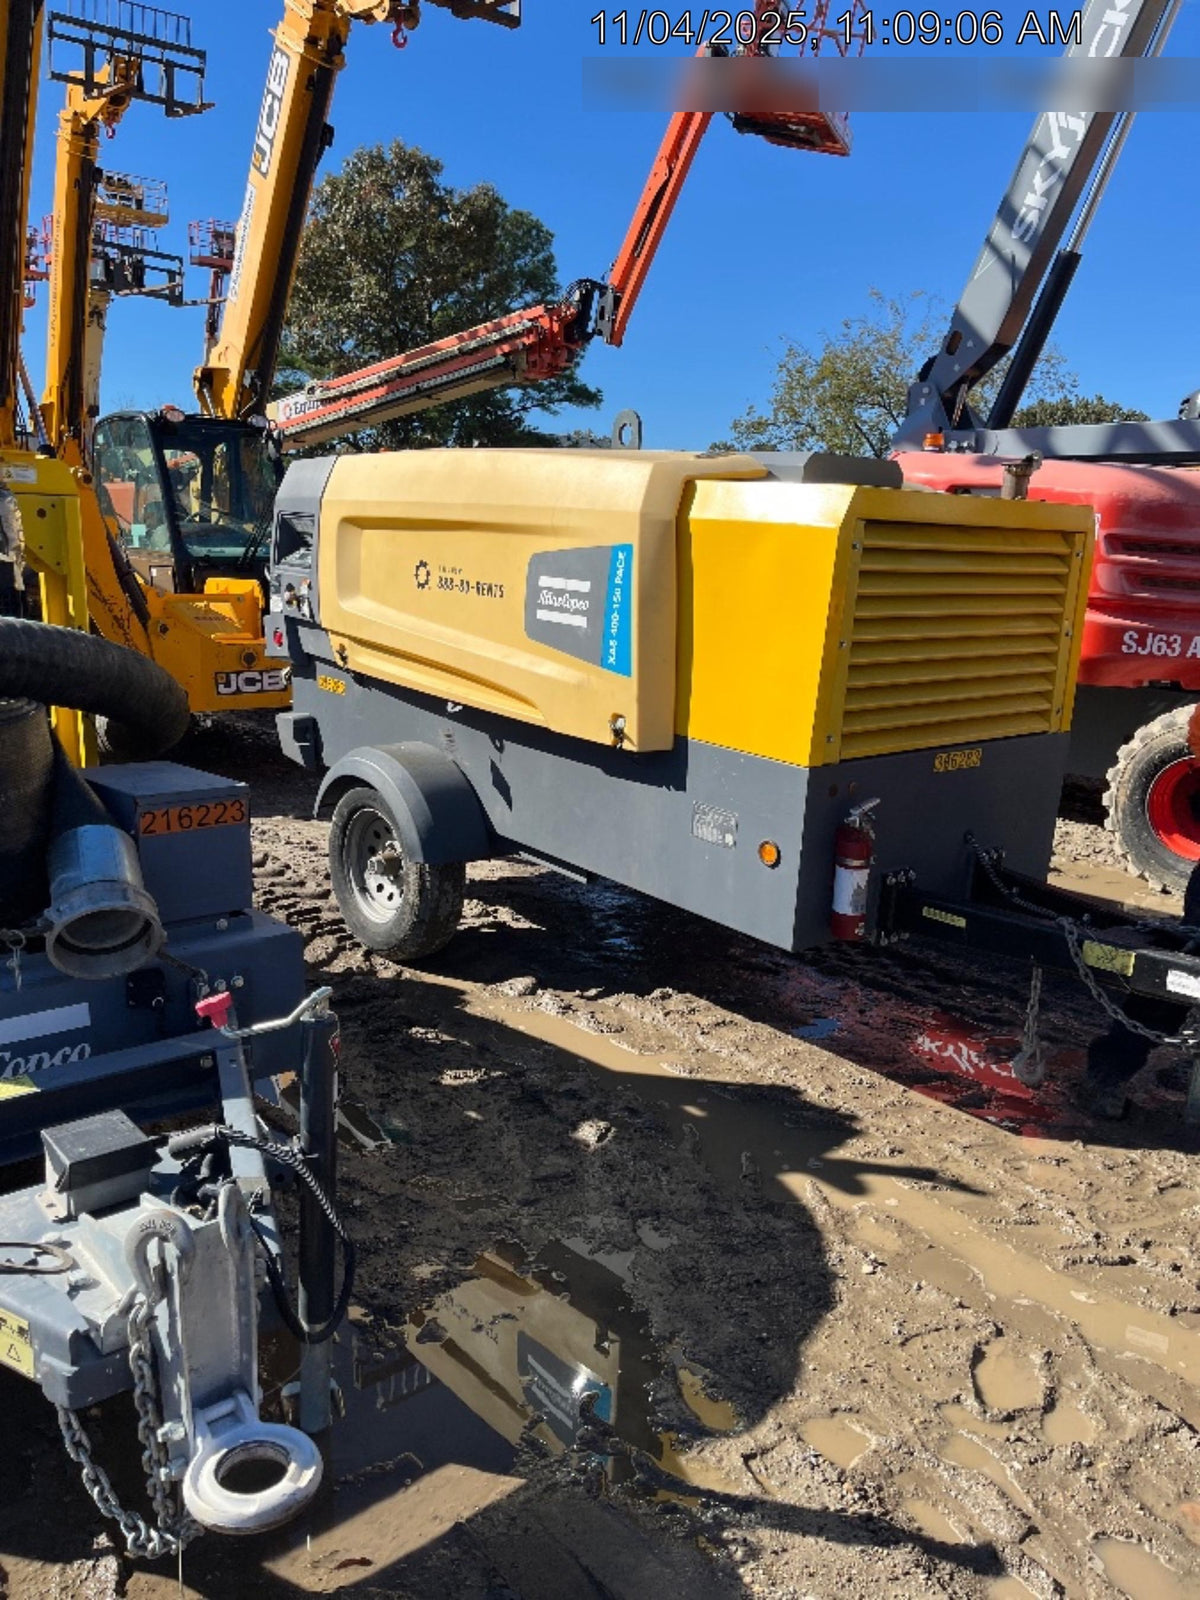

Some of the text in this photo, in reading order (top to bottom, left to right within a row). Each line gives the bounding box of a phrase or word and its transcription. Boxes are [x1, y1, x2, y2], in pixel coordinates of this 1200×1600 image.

[253, 50, 290, 175] JCB
[1121, 630, 1182, 657] SJ63
[217, 670, 286, 695] JCB
[141, 799, 245, 834] 216223
